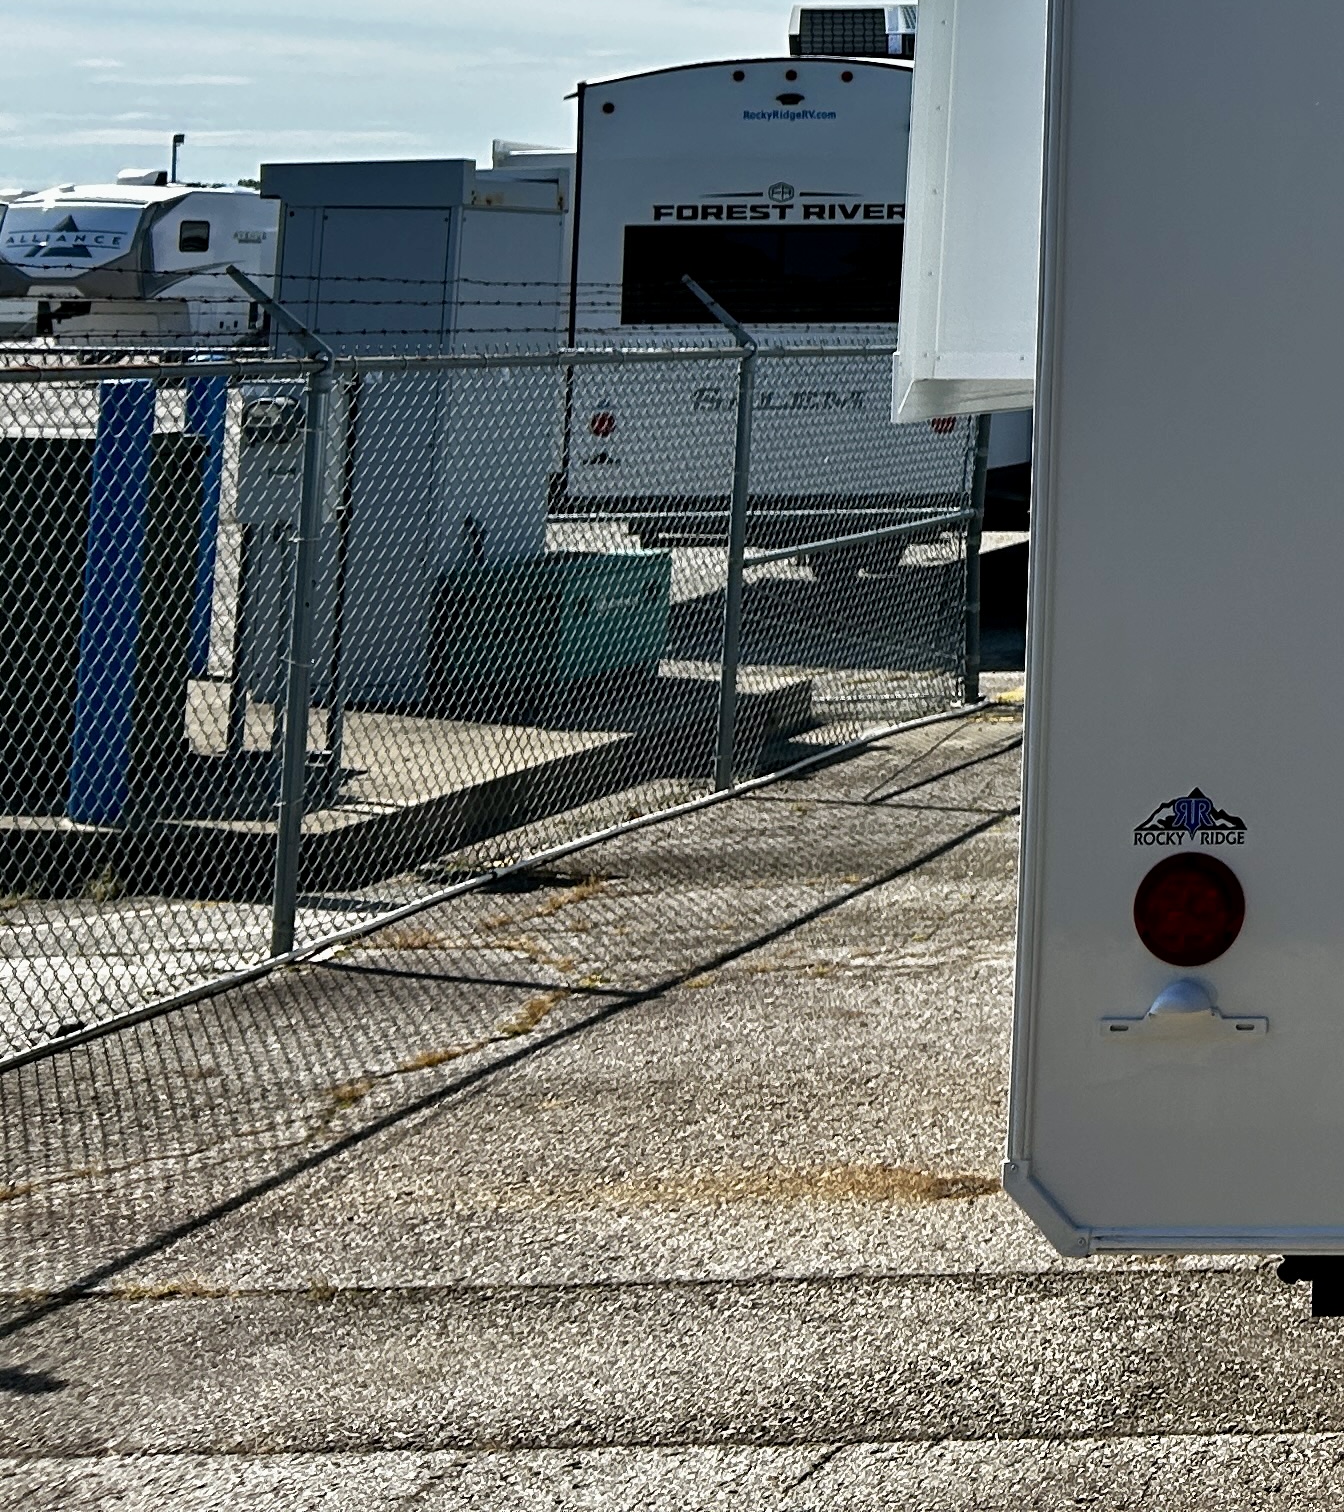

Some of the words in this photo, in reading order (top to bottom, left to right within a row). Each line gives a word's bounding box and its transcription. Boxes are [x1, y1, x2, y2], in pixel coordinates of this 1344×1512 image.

[743, 110, 837, 122] RockyRidgeRV.com
[653, 204, 794, 221] FOREST
[5, 234, 122, 246] ALLIANCE
[692, 388, 864, 411] SLEM
[1133, 831, 1186, 845] ROCKY
[1200, 831, 1245, 845] RIDGE
